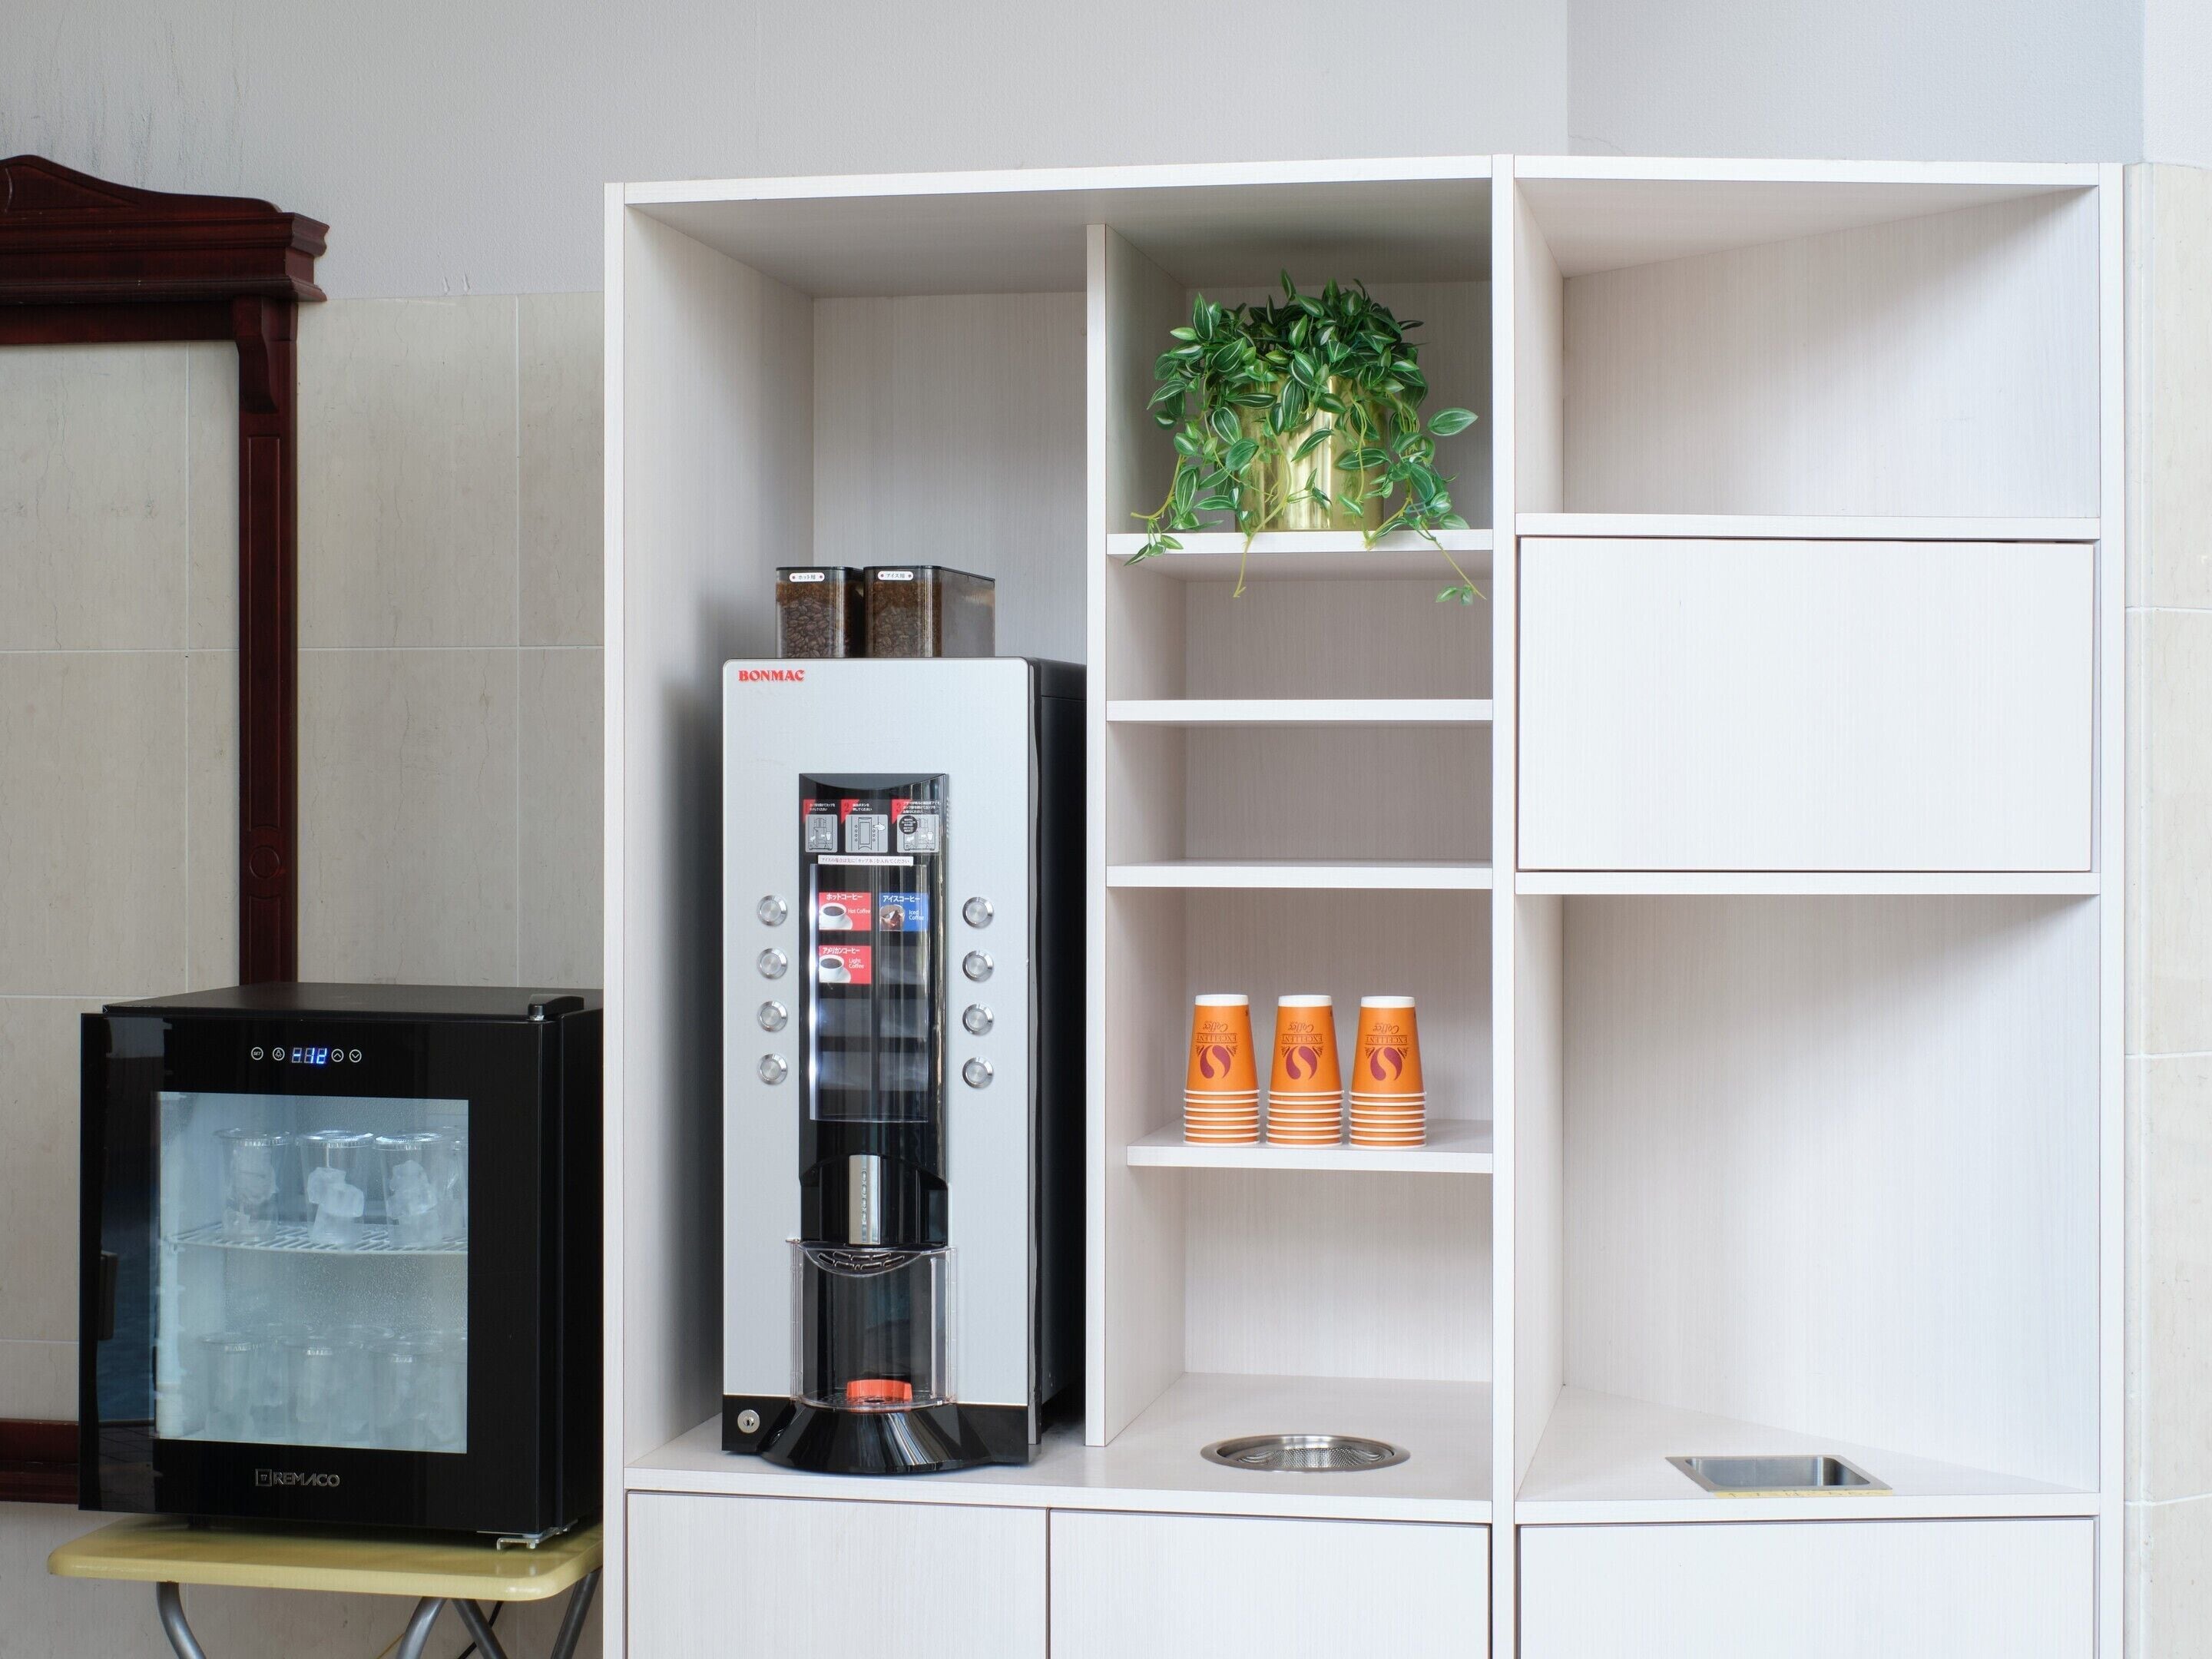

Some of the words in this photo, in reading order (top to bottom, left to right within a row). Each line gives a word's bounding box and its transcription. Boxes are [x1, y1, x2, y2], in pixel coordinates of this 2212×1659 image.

[738, 670, 805, 682] BONMAC
[1203, 1022, 1228, 1033] Coffee
[1287, 1022, 1314, 1034] Coffee
[1372, 1023, 1399, 1035] Coffee
[273, 1472, 340, 1487] REMACO
